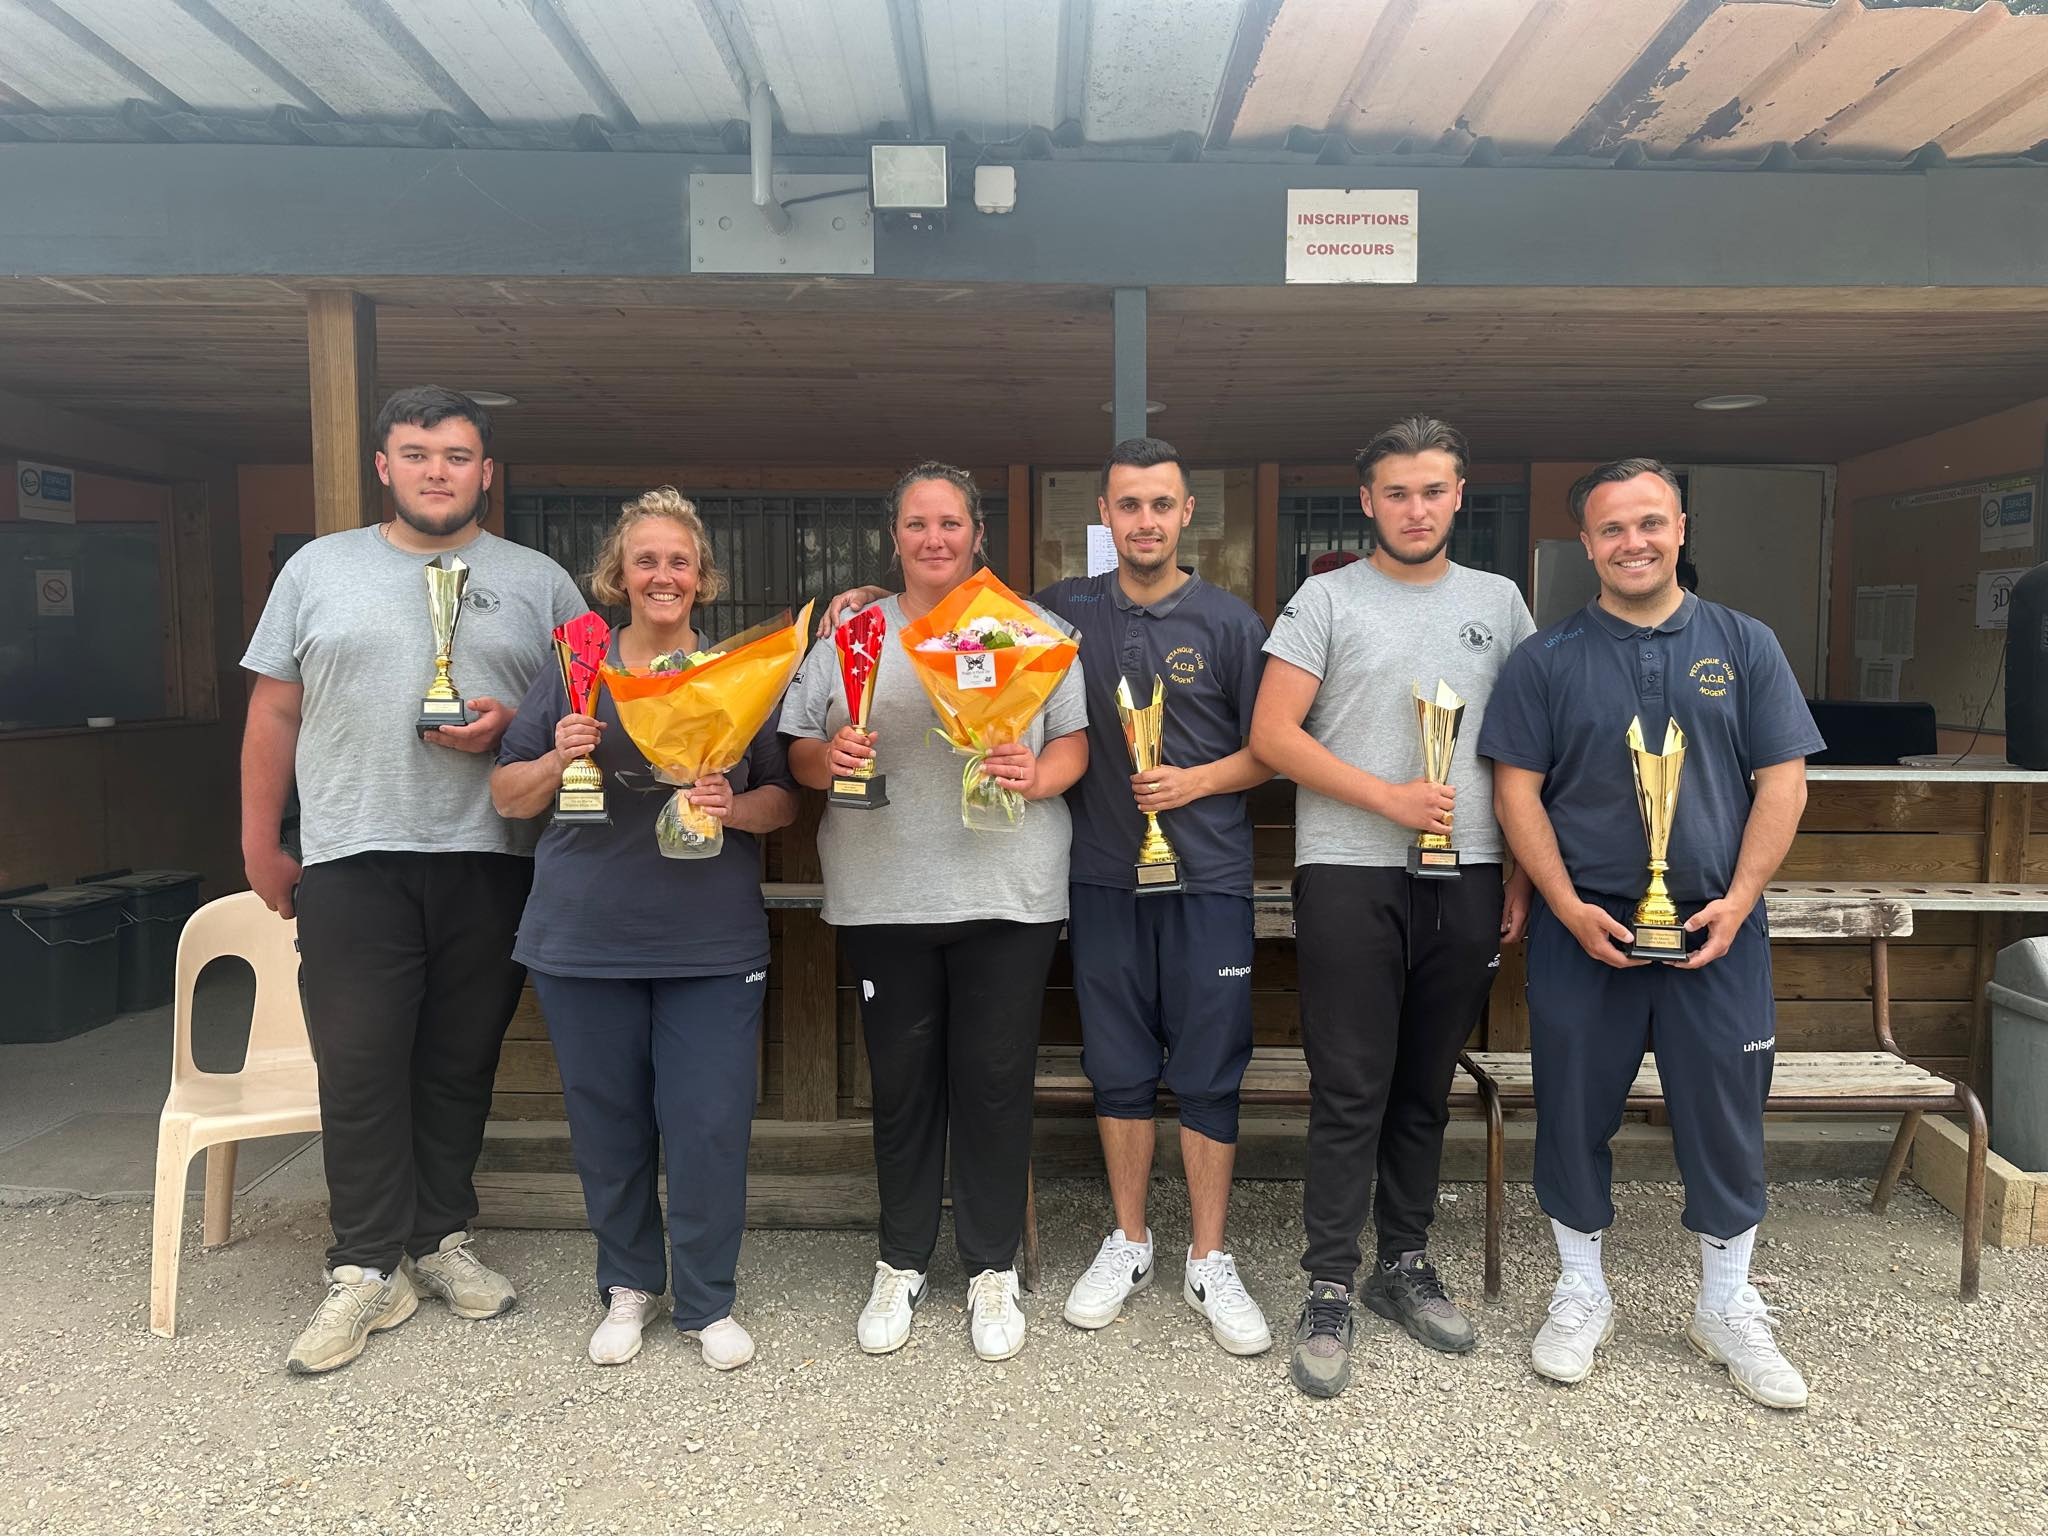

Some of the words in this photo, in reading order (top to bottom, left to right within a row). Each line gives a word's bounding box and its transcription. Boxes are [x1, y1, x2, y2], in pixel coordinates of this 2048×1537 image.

[1297, 213, 1410, 226] INSCRIPTIONS
[1306, 243, 1395, 256] CONCOURS
[1165, 646, 1194, 664] PETANQUE
[1194, 653, 1205, 670] CLUB
[1689, 657, 1720, 678] PETANQUE
[1722, 662, 1735, 681] CLUB
[1169, 672, 1195, 684] NOGENT
[1699, 673, 1726, 685] A.C.B.
[1698, 686, 1728, 697] NOGENT
[1218, 965, 1251, 977] uhlspo
[1743, 1034, 1776, 1052] uhlspo
